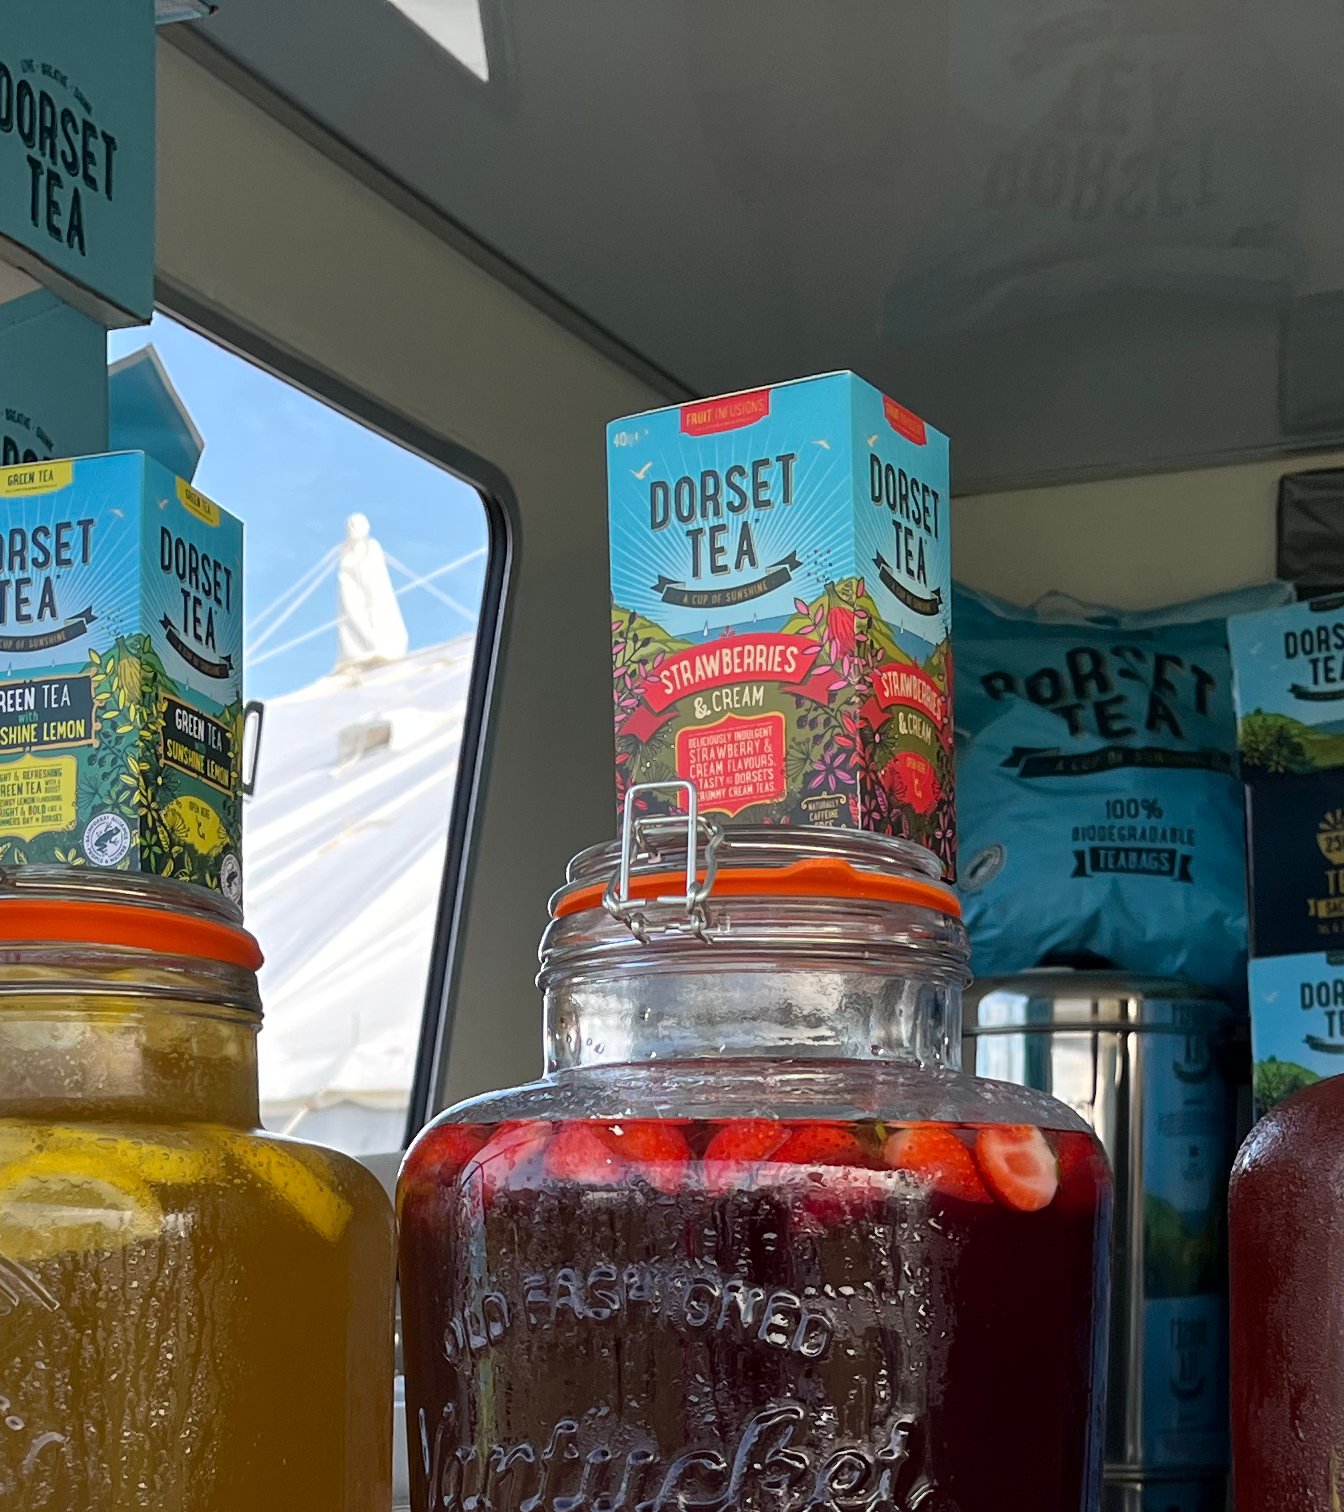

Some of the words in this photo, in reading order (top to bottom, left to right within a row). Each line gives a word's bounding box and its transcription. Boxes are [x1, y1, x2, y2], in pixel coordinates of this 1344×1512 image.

[27, 154, 86, 257] TEA
[686, 408, 713, 427] FRUIT
[715, 399, 765, 419] INFUSIONS
[7, 471, 35, 486] GREEN
[39, 469, 54, 483] TEA
[650, 452, 797, 532] DORSET
[870, 453, 940, 540] DORSET
[686, 519, 758, 580] TEA
[892, 520, 927, 588] TEA
[159, 526, 233, 615] DORSET
[692, 594, 708, 605] CUP
[726, 580, 768, 602] SUNSHINE
[180, 587, 217, 651] TEA
[660, 644, 799, 695] STRAWBERRIES
[41, 684, 71, 709] TEA
[694, 697, 711, 719] &
[712, 686, 764, 712] CREAM
[881, 671, 942, 721] STRAWBERRIES
[18, 711, 39, 724] with
[43, 719, 85, 741] LEMON
[175, 708, 205, 743] GREEN
[207, 722, 223, 753] TEA
[898, 712, 908, 735] &
[908, 713, 932, 746] CREAM
[1053, 695, 1184, 740] TEA
[166, 738, 205, 775] SUNSHINE
[207, 758, 230, 788] LEMON
[690, 739, 761, 764] STRAWBERRY
[764, 738, 772, 753] &
[690, 760, 723, 779] CREAM
[699, 776, 724, 790] TASTY
[735, 768, 774, 785] DORSETS
[25, 781, 42, 795] TEA
[728, 784, 753, 797] CREAM
[809, 810, 839, 821] CAFFEINE
[1106, 798, 1165, 820] 100%
[1071, 825, 1195, 847] BIODEGRADABLE
[1099, 849, 1170, 871] TEABAGS
